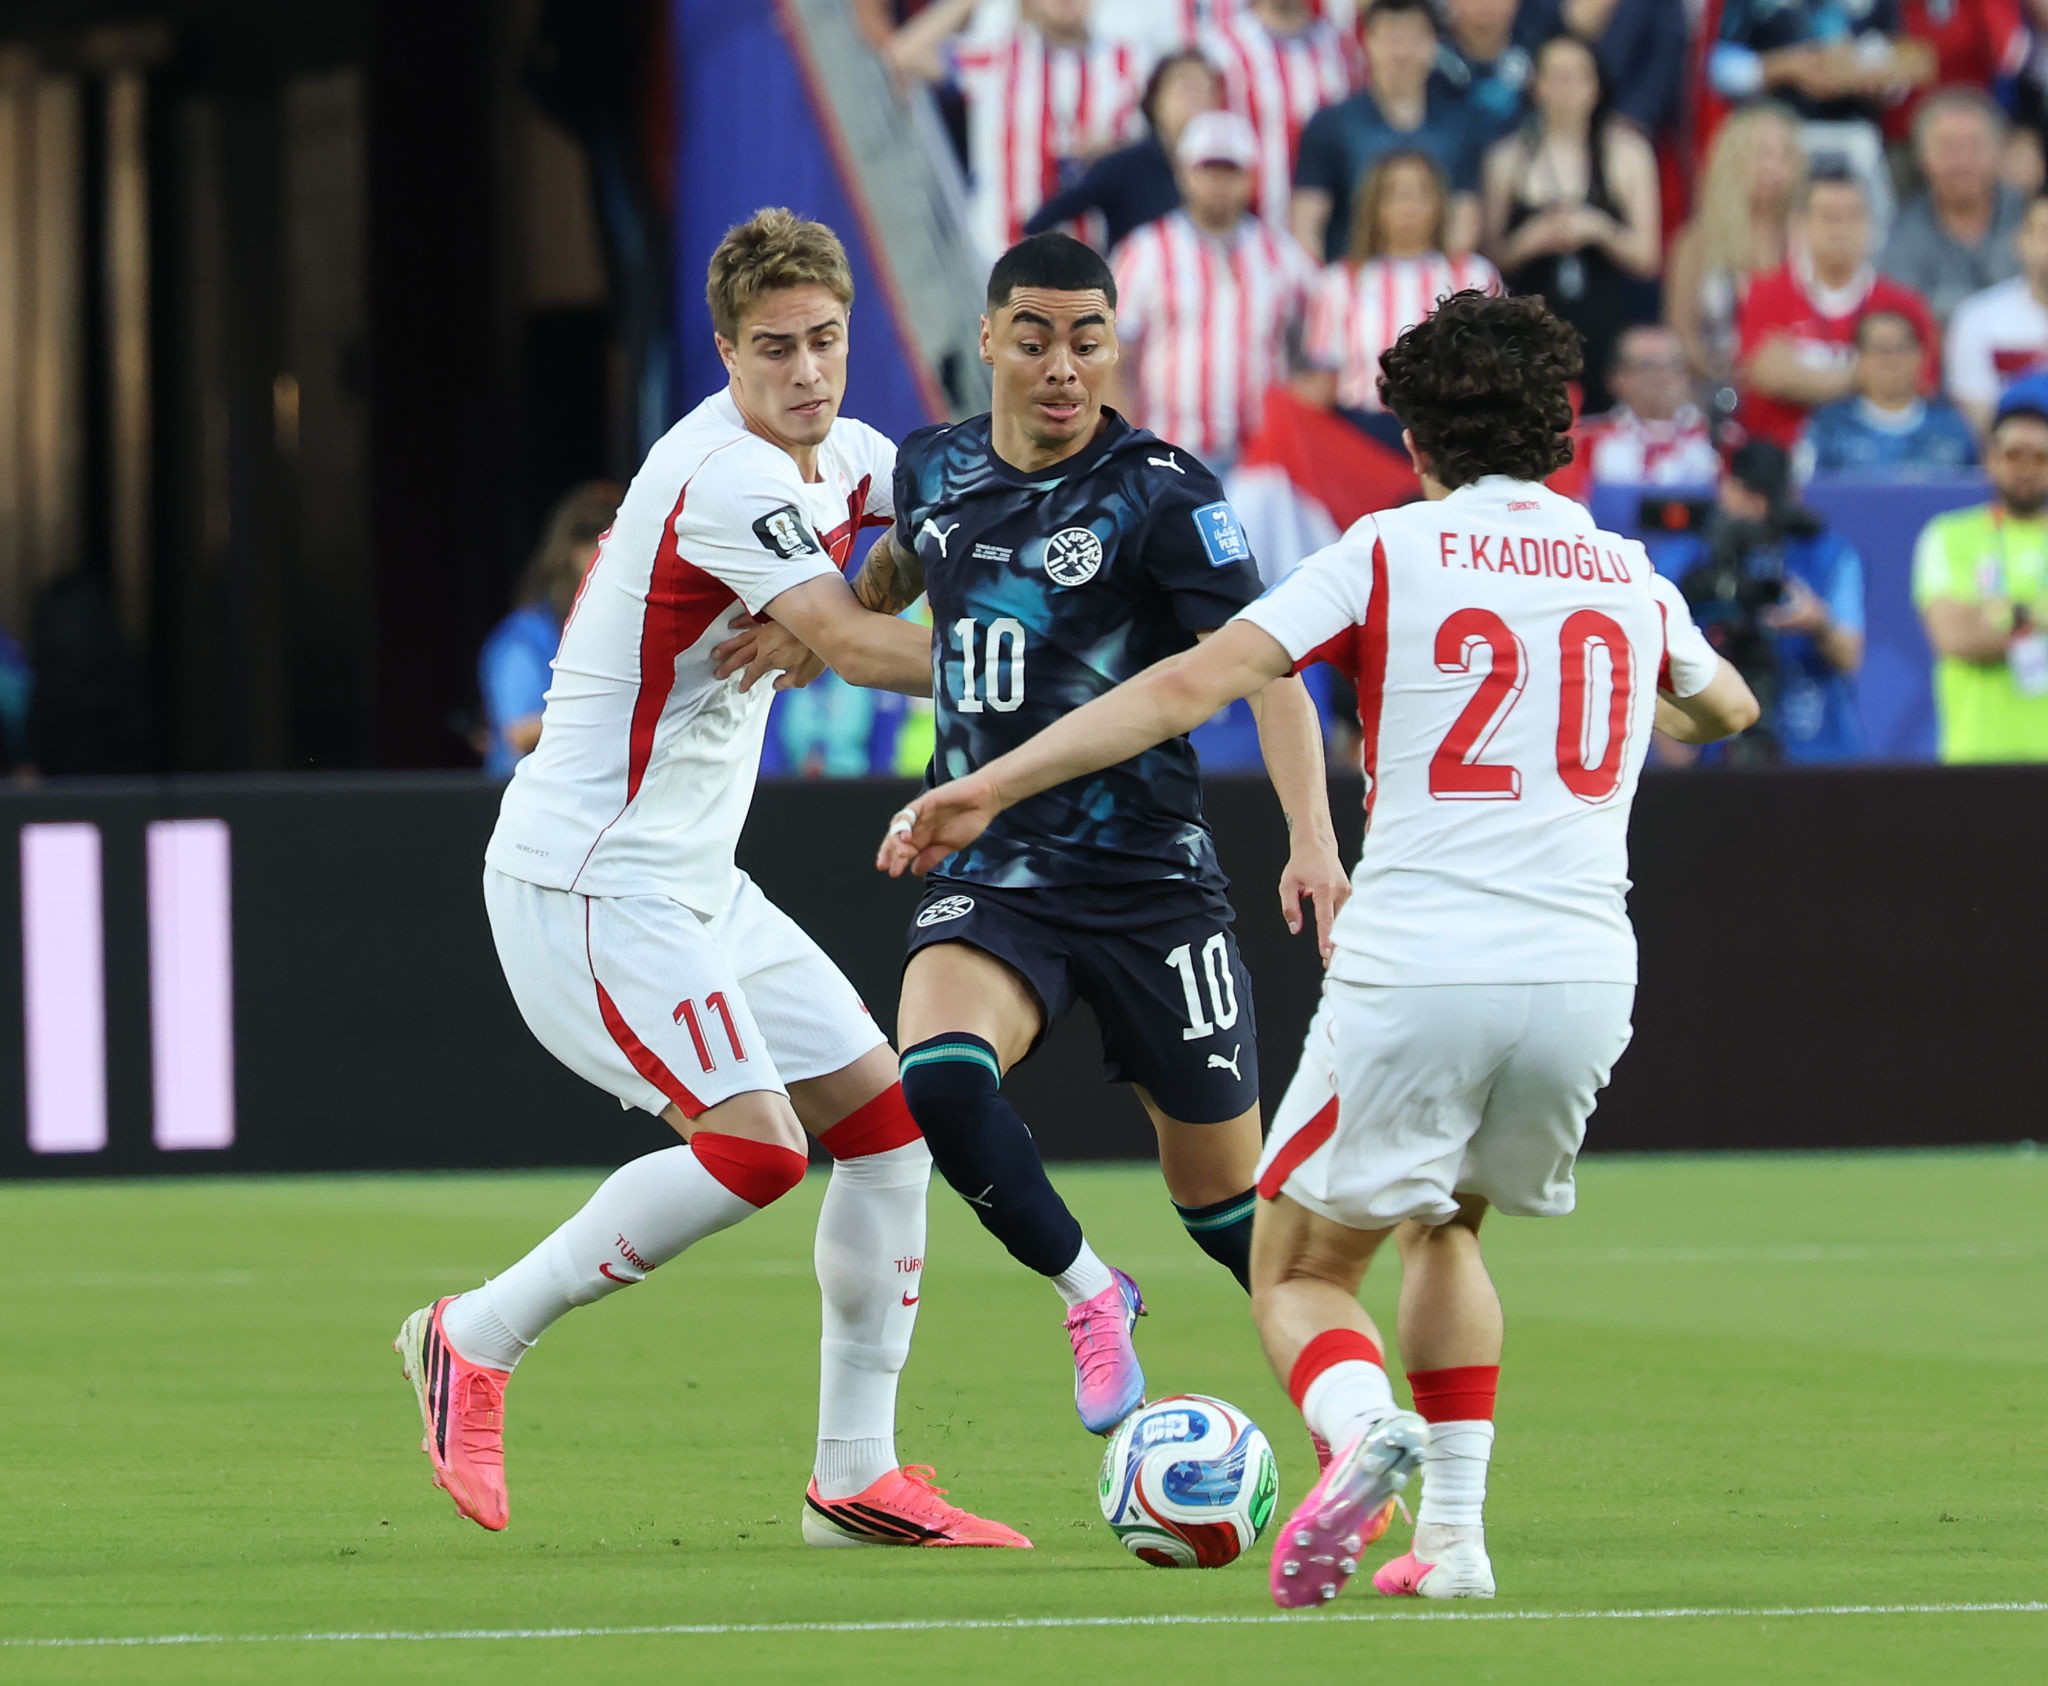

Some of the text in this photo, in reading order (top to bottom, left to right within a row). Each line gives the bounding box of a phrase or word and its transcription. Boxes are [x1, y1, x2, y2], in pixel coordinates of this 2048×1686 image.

[1440, 532, 1632, 584] F.KADIOĞLU
[953, 617, 1026, 713] 10
[1429, 607, 1637, 805] 20
[672, 991, 749, 1074] 11
[1164, 931, 1239, 1041] 10
